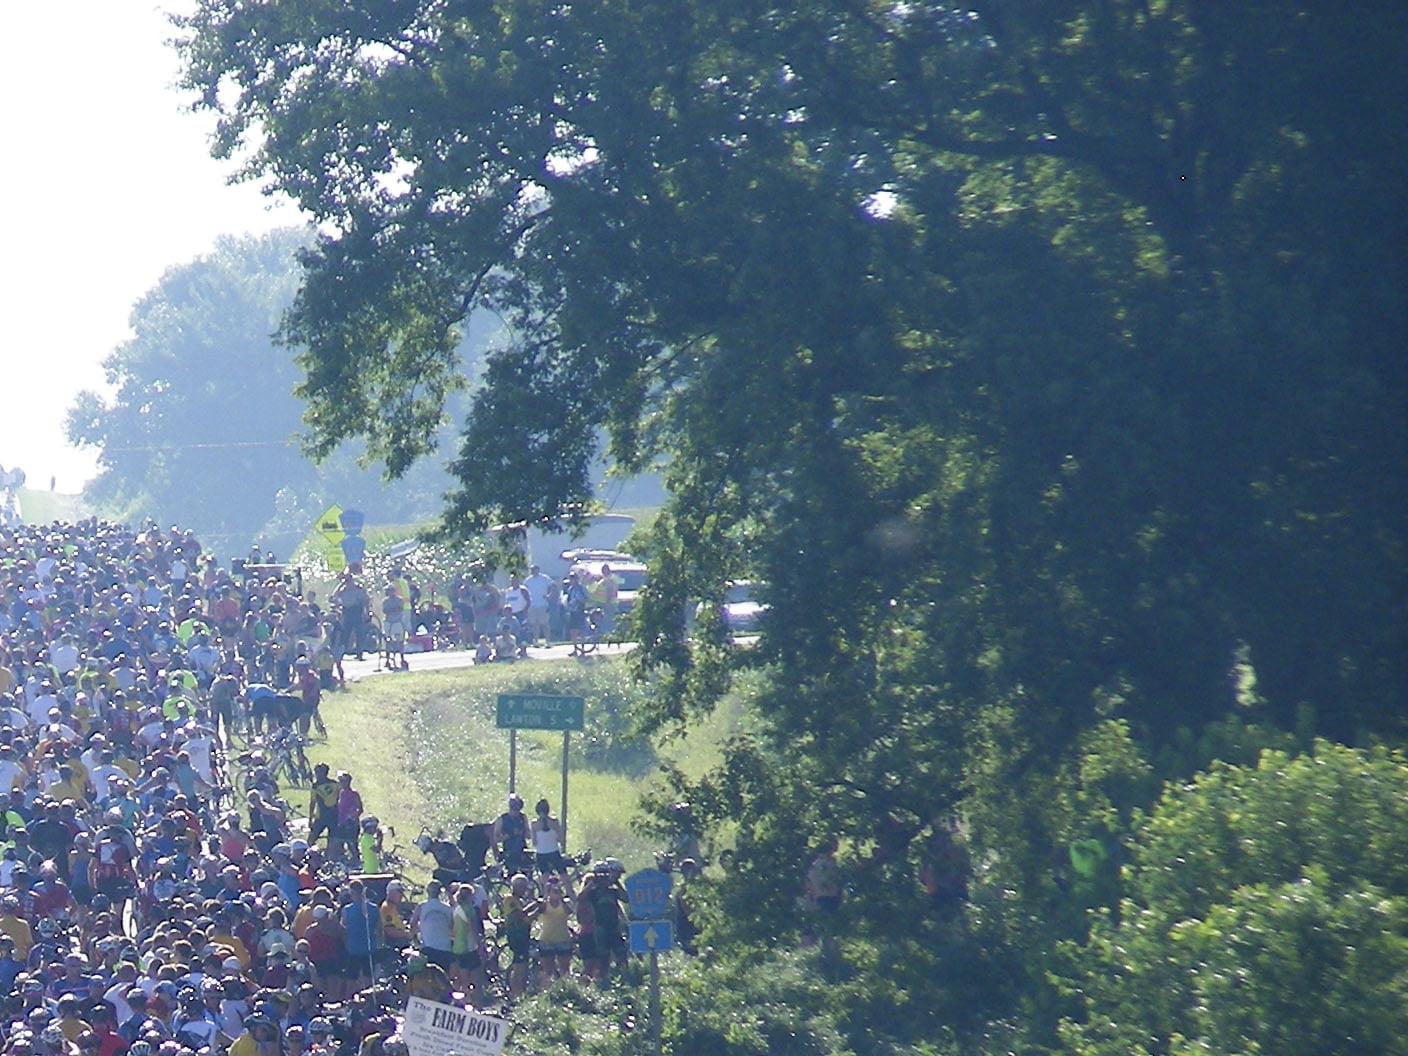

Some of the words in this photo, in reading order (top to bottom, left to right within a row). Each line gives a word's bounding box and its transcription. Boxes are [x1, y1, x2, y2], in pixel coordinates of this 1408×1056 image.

[414, 1002, 431, 1012] The
[432, 1007, 467, 1034] FARM
[467, 1017, 500, 1042] BOYS
